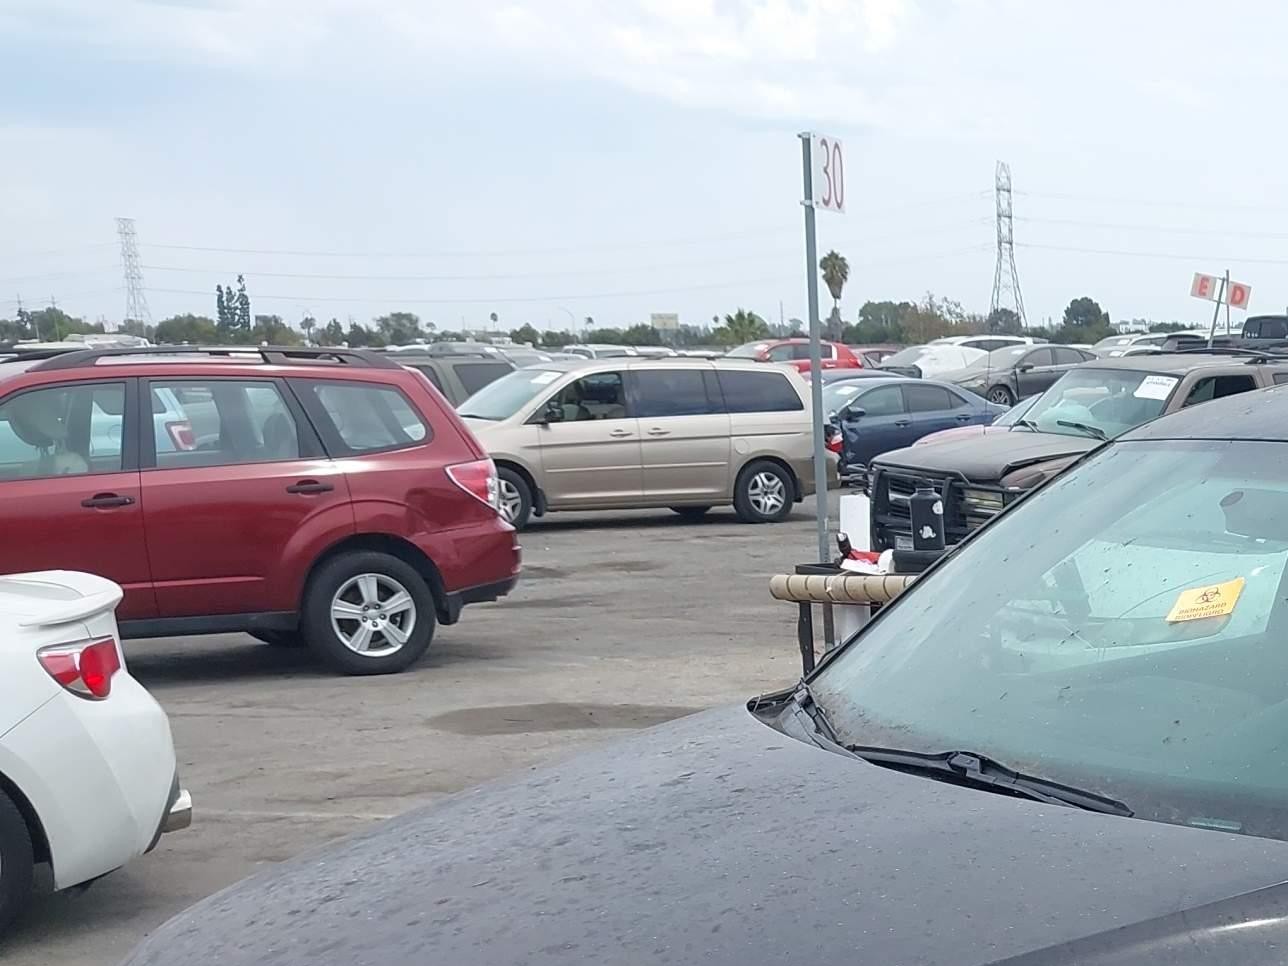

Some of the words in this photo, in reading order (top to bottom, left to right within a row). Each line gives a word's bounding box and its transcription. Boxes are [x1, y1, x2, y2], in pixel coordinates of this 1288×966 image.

[820, 138, 844, 209] 30
[1198, 277, 1210, 297] E
[1230, 285, 1245, 305] D
